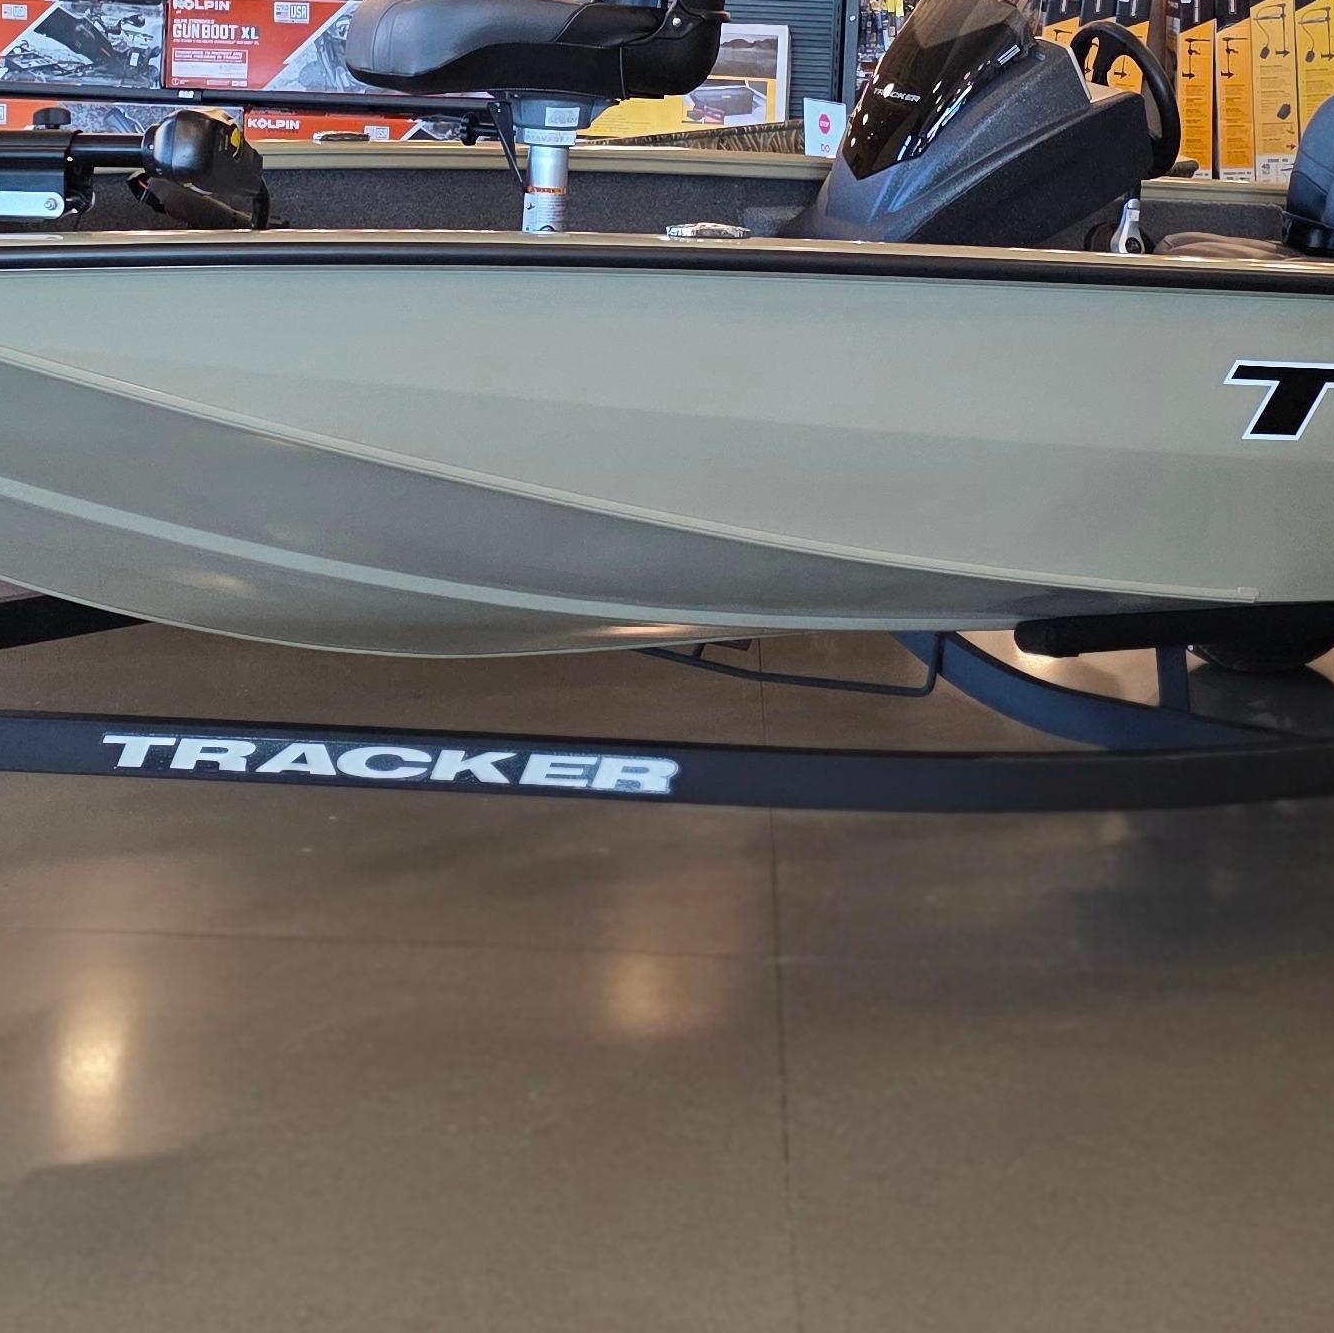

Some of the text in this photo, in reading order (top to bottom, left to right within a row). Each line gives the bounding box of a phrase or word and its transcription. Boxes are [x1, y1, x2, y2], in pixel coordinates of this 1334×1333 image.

[290, 4, 307, 19] USA
[172, 23, 260, 40] GUN BOOT XL
[247, 117, 300, 130] KOLPIN
[102, 734, 680, 795] TRACKER
